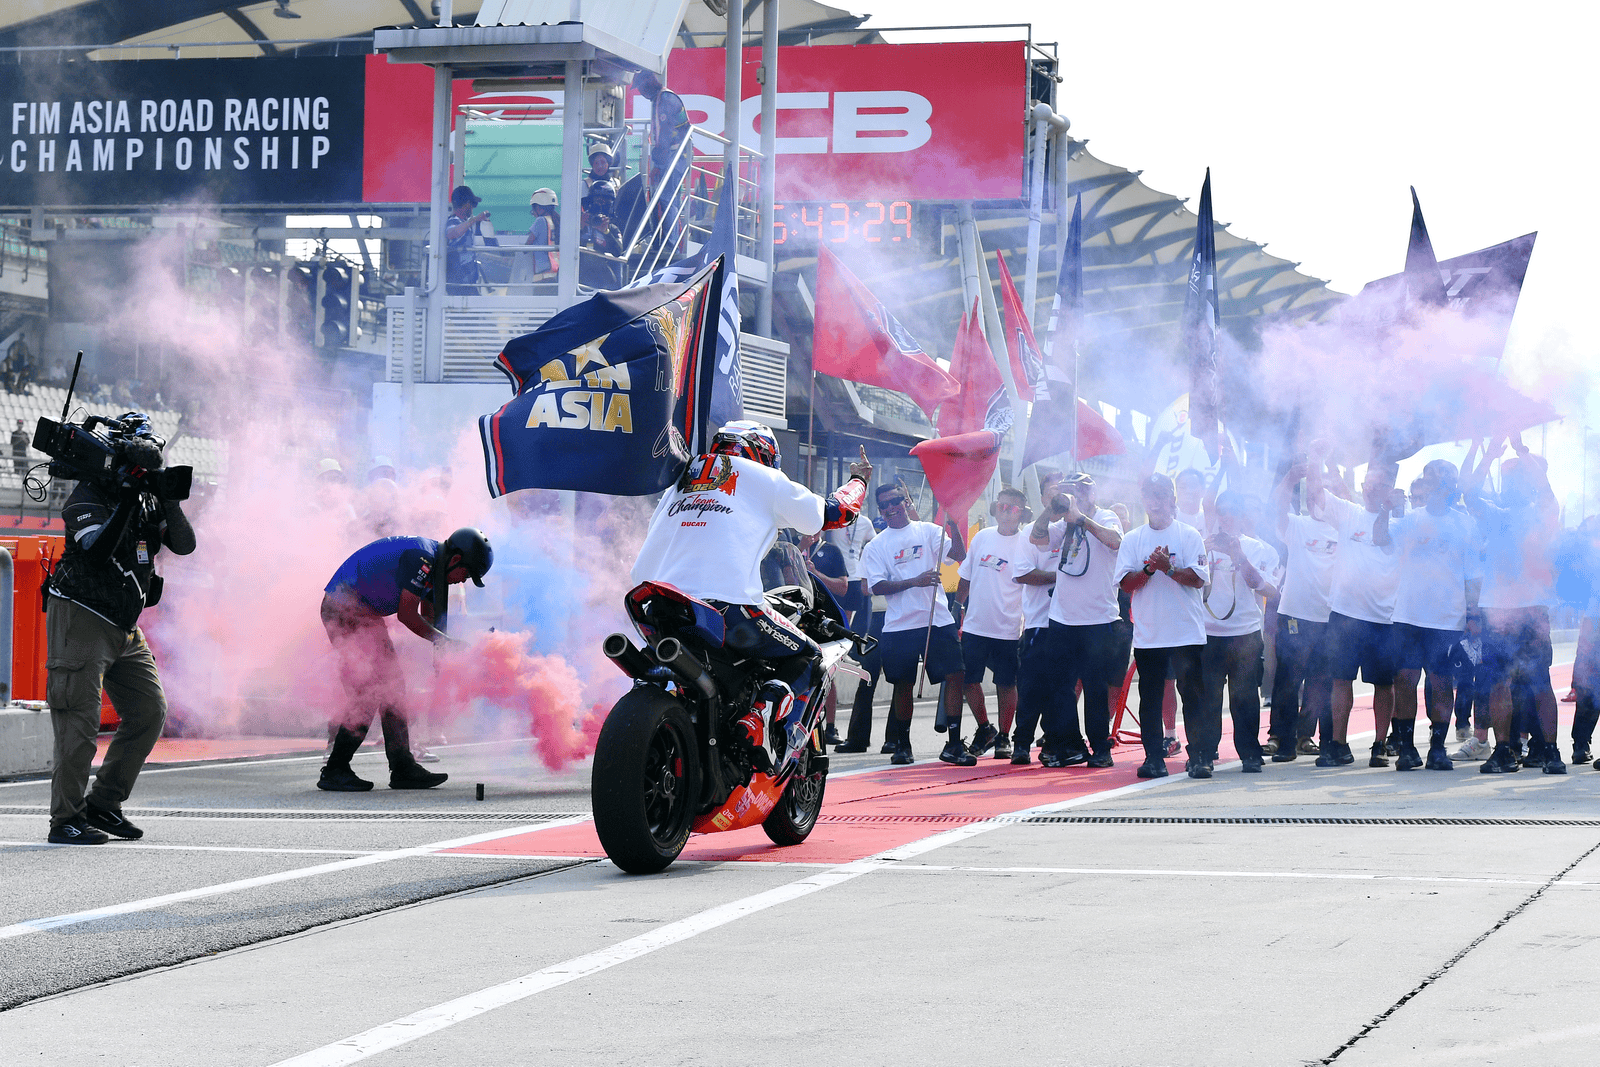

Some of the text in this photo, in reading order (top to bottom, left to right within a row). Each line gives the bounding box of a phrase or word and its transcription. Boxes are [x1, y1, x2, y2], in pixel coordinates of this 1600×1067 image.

[12, 96, 330, 134] FIM ASIA ROAD RACING
[632, 90, 933, 155] RCB
[10, 136, 330, 172] CHAMPIONSHIP
[525, 390, 633, 434] ASIA
[667, 498, 734, 519] Champion
[687, 493, 716, 505] Team
[756, 618, 800, 651] alpinestars
